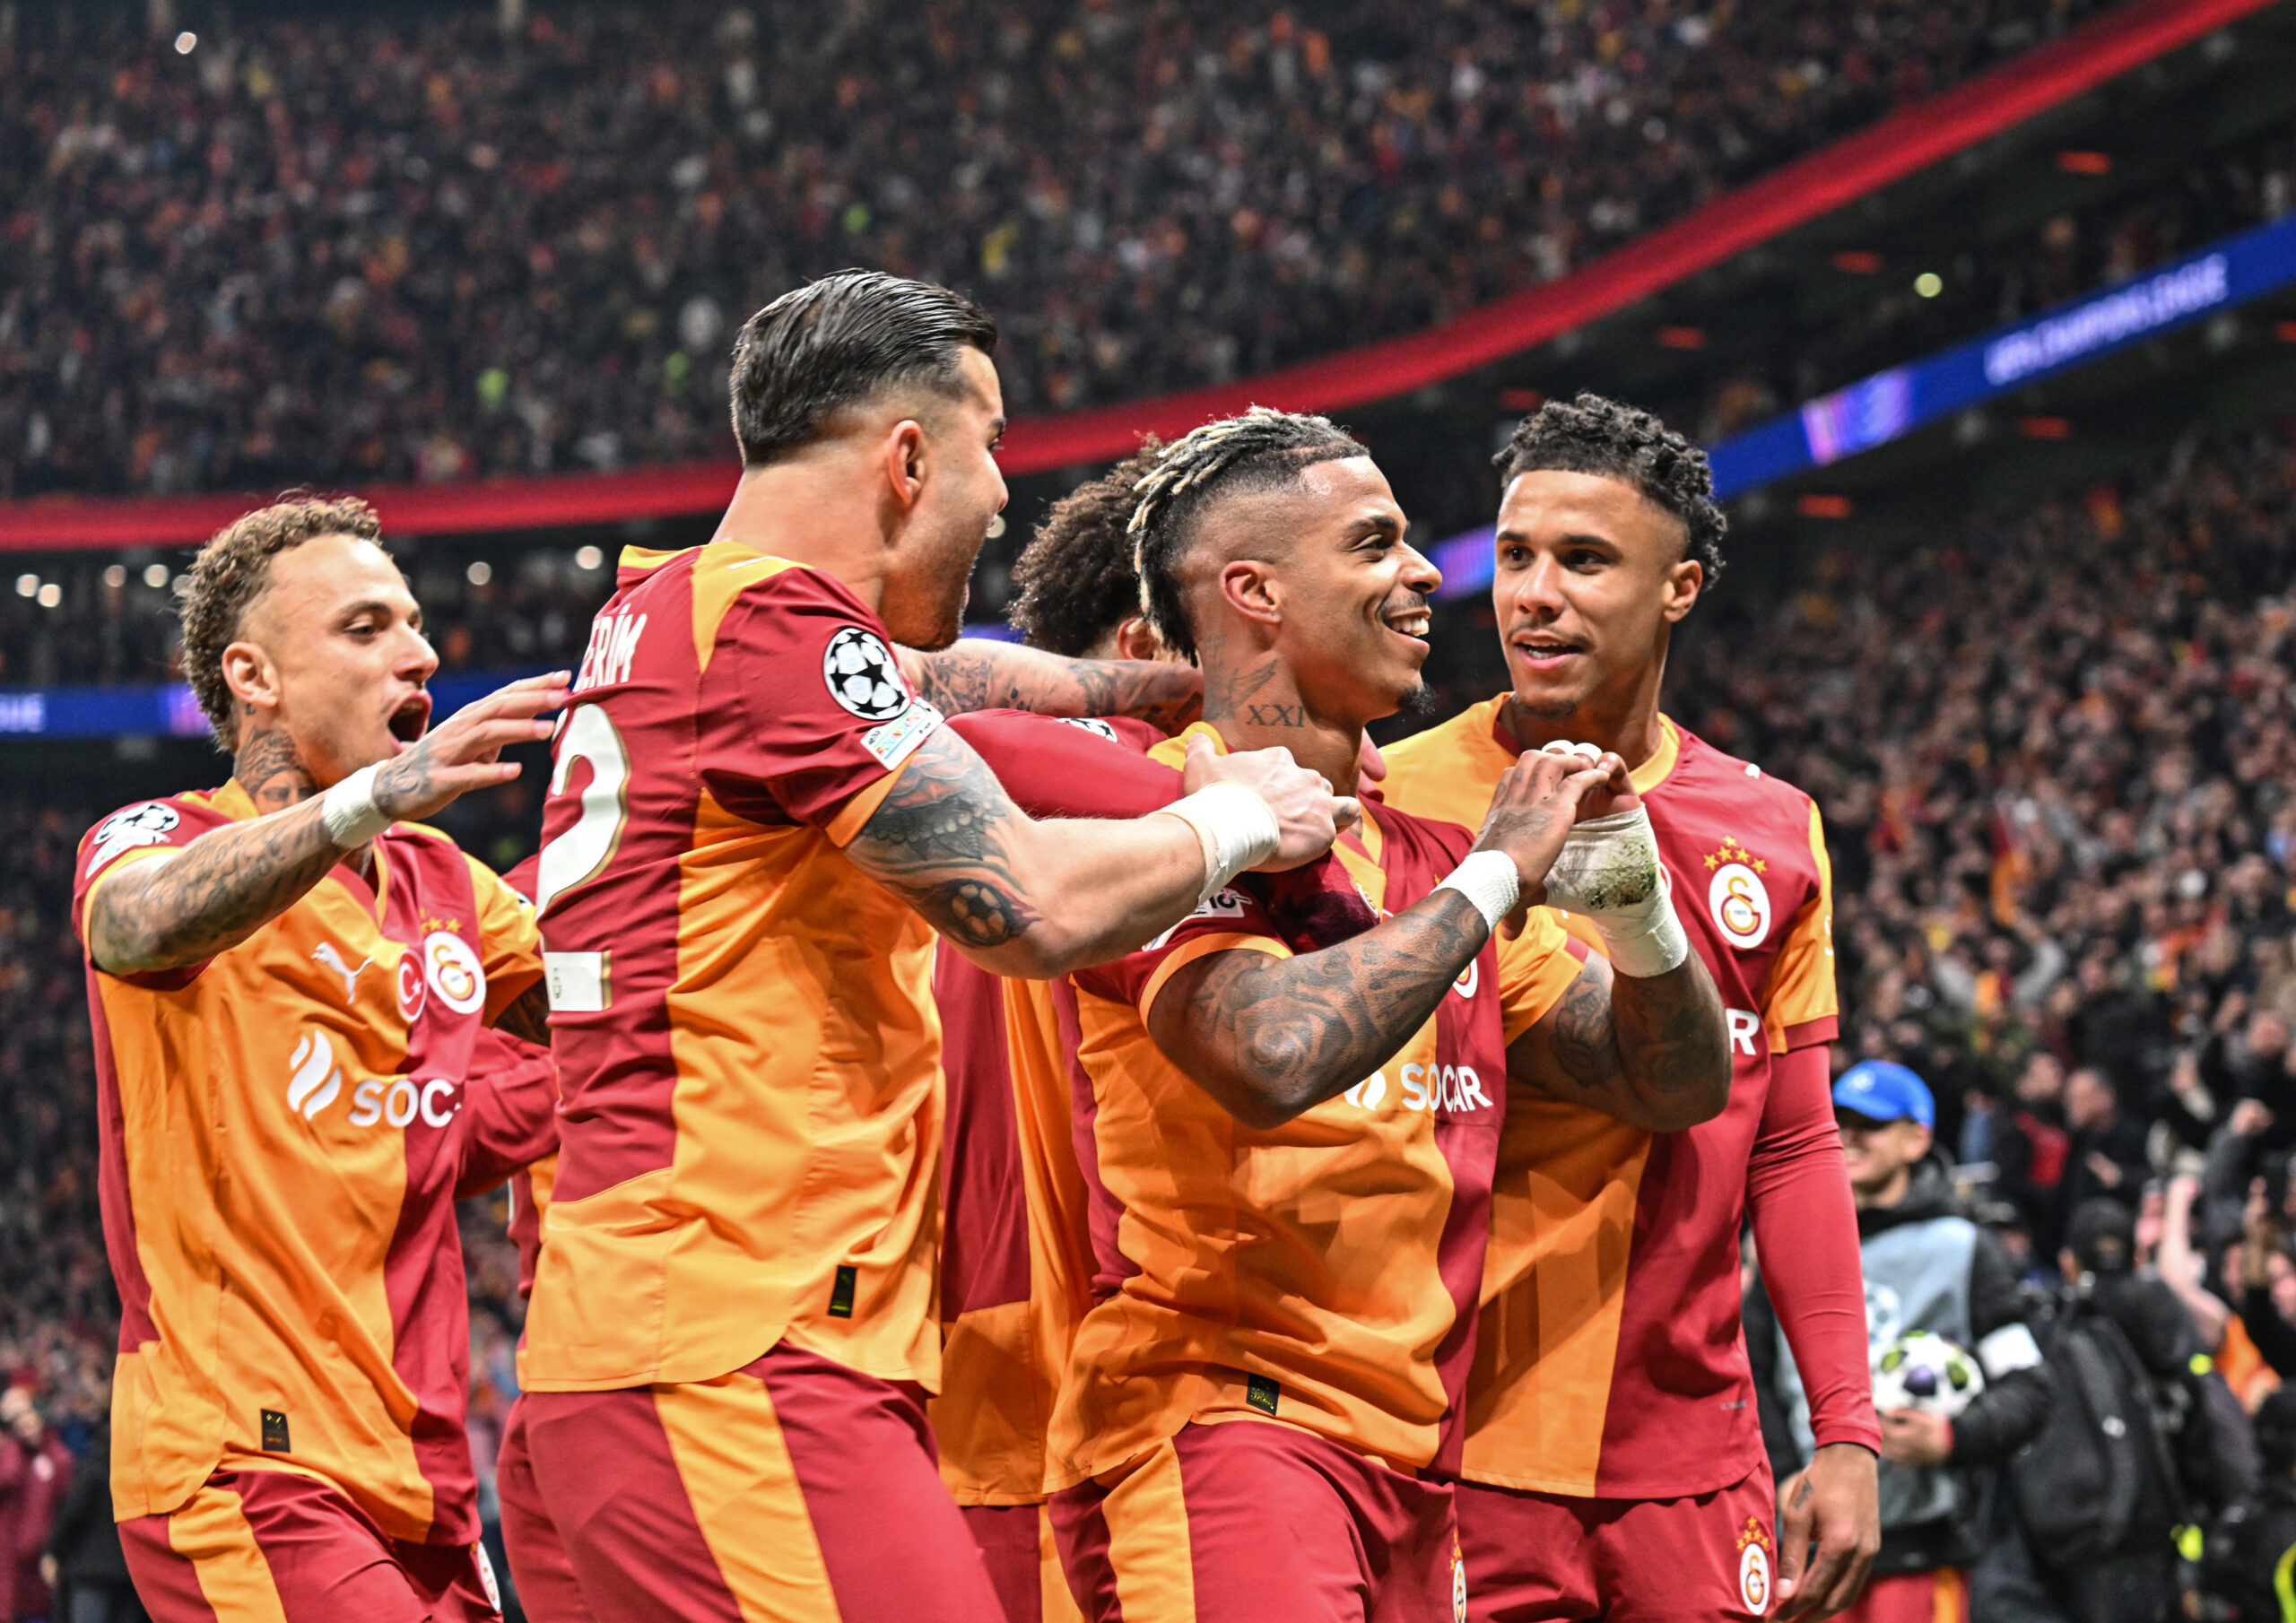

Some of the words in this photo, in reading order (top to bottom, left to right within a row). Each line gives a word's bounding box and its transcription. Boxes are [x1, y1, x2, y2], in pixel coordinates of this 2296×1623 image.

[572, 603, 648, 693] ERİM
[1246, 704, 1305, 727] XXI
[535, 703, 631, 1011] 2
[348, 1079, 462, 1128] SOC
[1400, 1062, 1493, 1112] SOCAR
